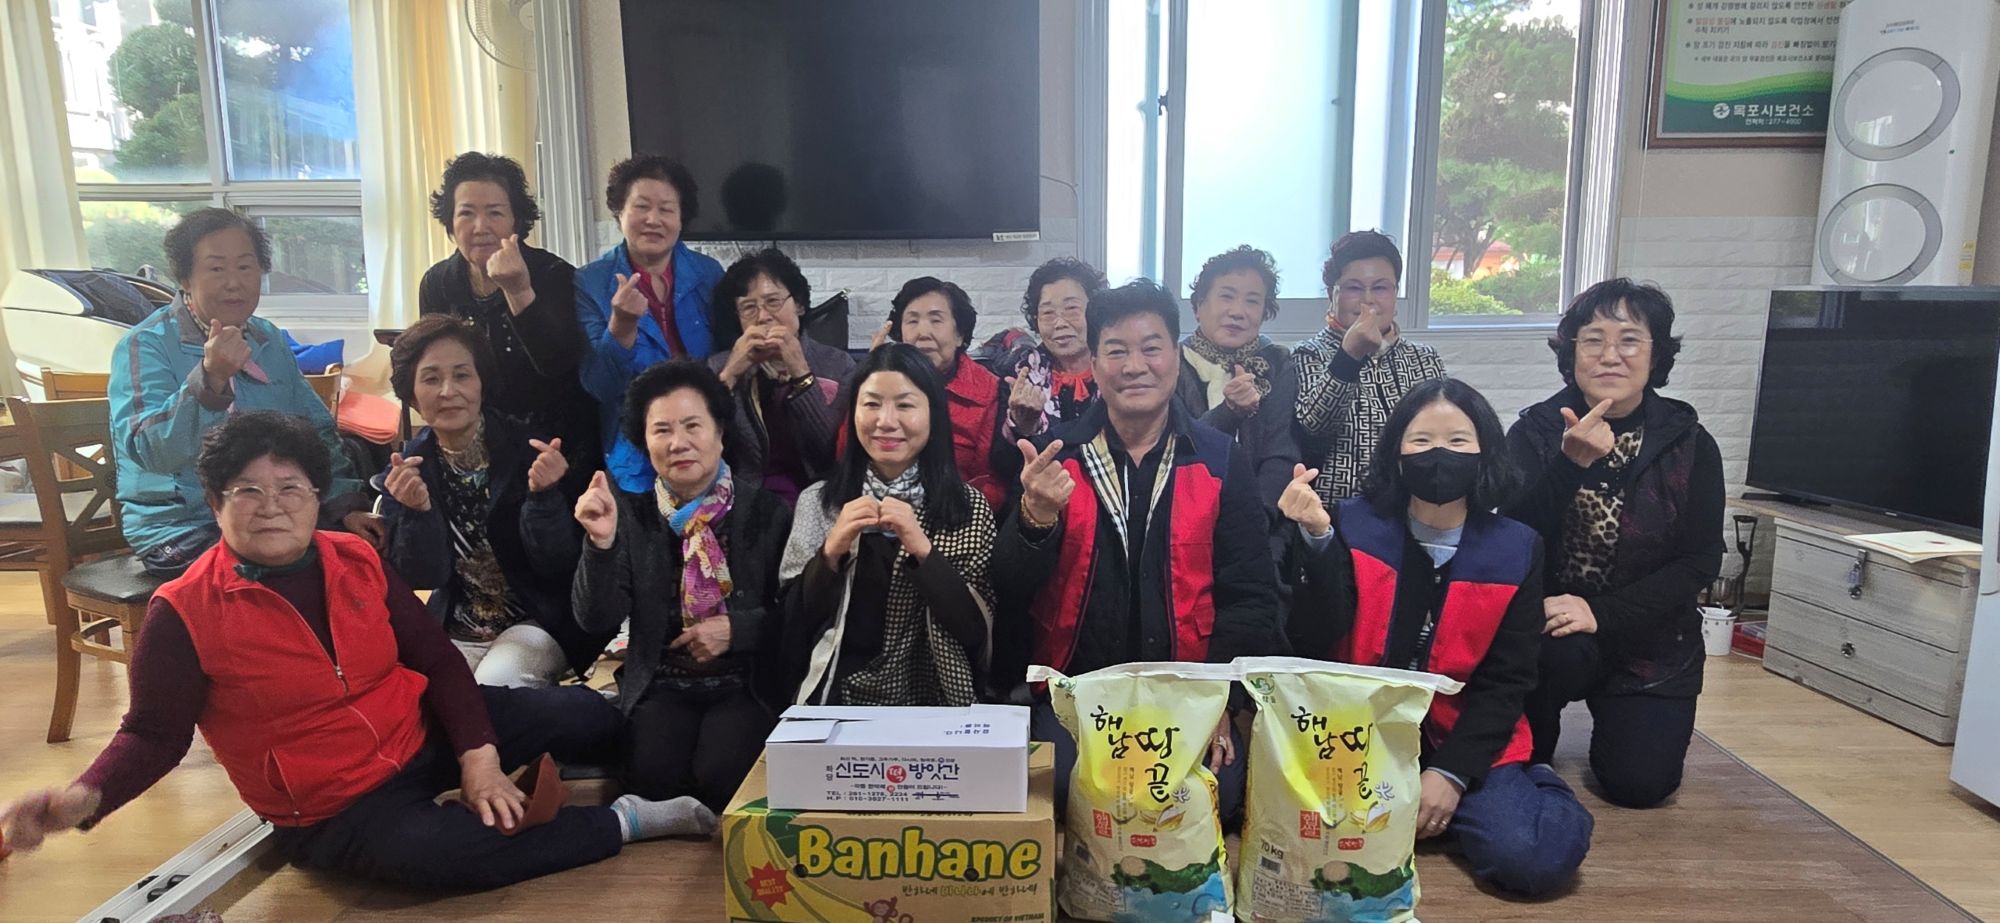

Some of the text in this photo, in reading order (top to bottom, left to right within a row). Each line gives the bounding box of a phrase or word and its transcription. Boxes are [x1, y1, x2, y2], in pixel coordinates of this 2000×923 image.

[1733, 104, 1815, 117] 목포시보건소
[836, 762, 885, 779] 신도시
[908, 763, 960, 780] 방앗간
[798, 825, 1042, 881] Banhane
[1271, 845, 1284, 860] kg
